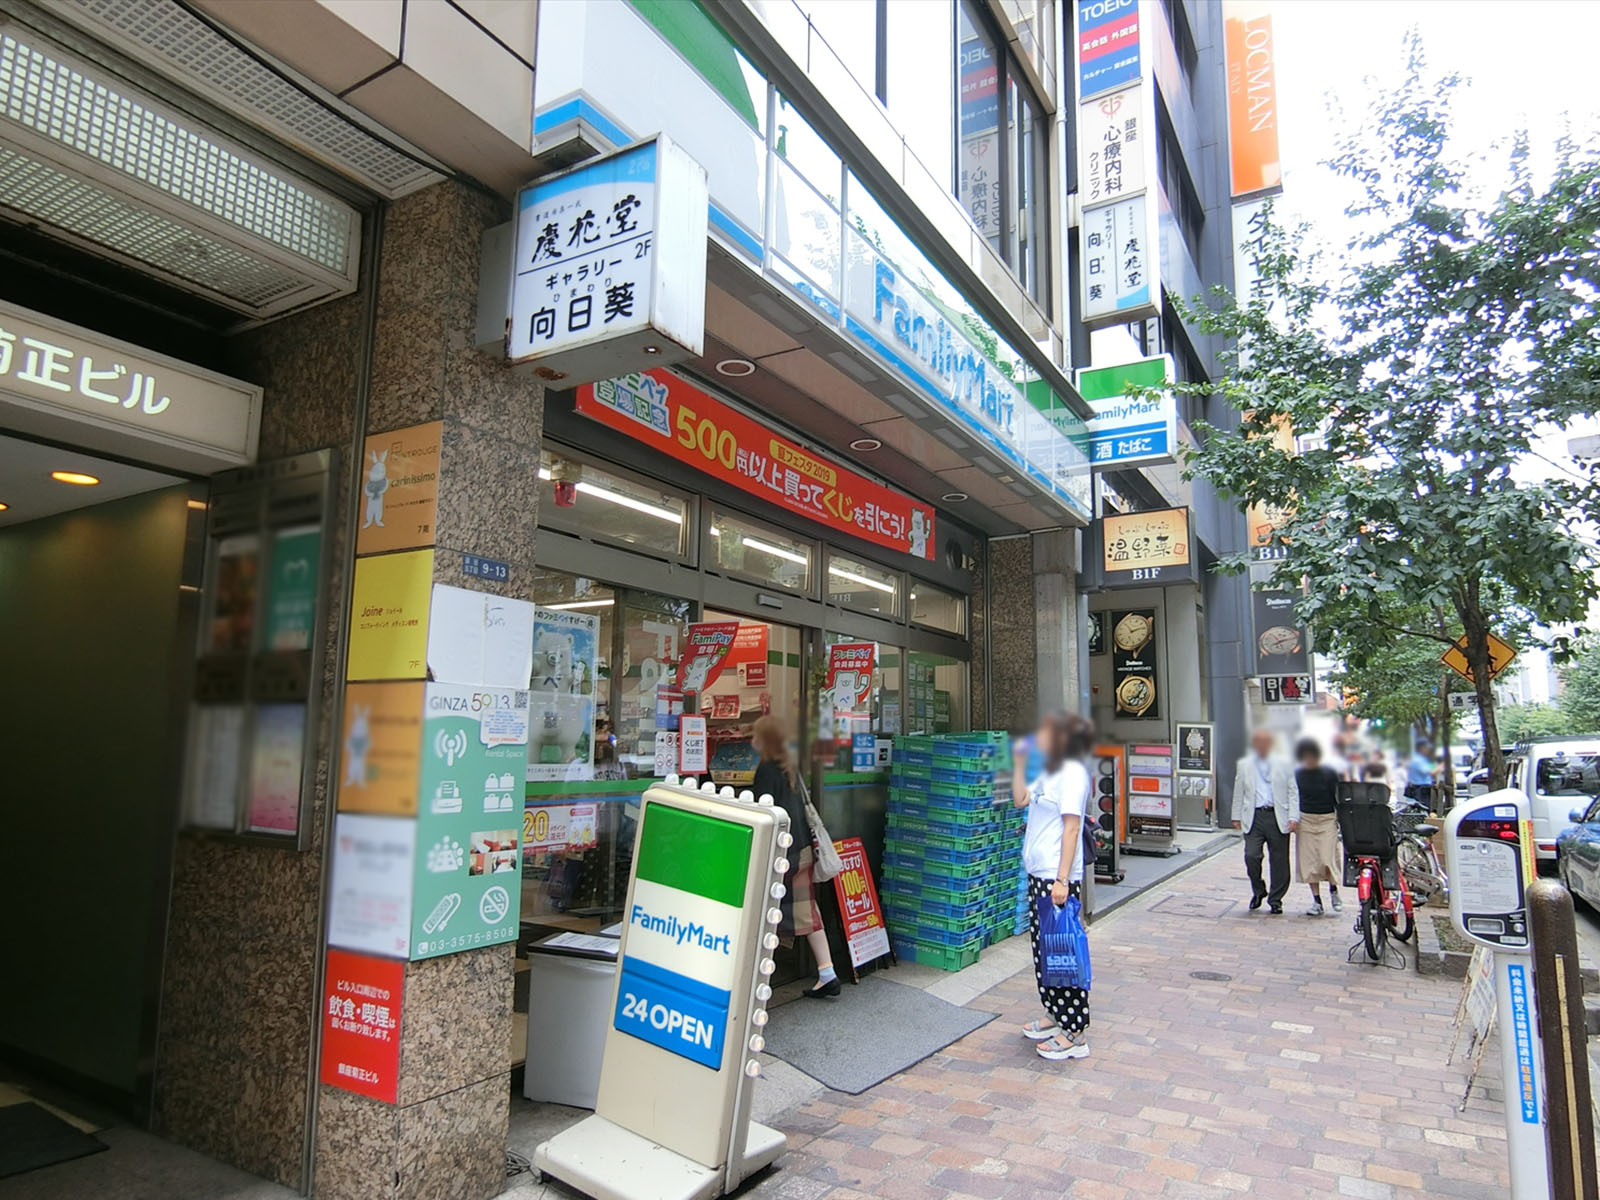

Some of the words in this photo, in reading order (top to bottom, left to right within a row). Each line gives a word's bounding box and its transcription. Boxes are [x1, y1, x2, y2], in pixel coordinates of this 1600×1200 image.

[1103, 125, 1123, 195] 心療内科
[1089, 152, 1102, 200] クリニック
[546, 259, 622, 289] ギャラリー
[635, 239, 652, 260] 2F
[1088, 232, 1103, 302] 向日葵
[553, 277, 612, 303] ひまわり
[529, 282, 635, 344] 向日葵
[873, 256, 1015, 438] FamilyMart
[1095, 402, 1160, 420] amilyMart
[1096, 441, 1113, 459] 酒
[1117, 438, 1152, 455] たばこ
[482, 562, 506, 578] 9-13
[361, 605, 383, 617] Joine
[691, 632, 734, 645] FamiPay
[834, 648, 871, 659] ファミペイ
[429, 695, 468, 711] GINZA
[471, 692, 510, 712] 5913
[846, 893, 870, 915] セール
[430, 926, 514, 951] 03-3575-8508
[631, 905, 731, 955] FamilyMart
